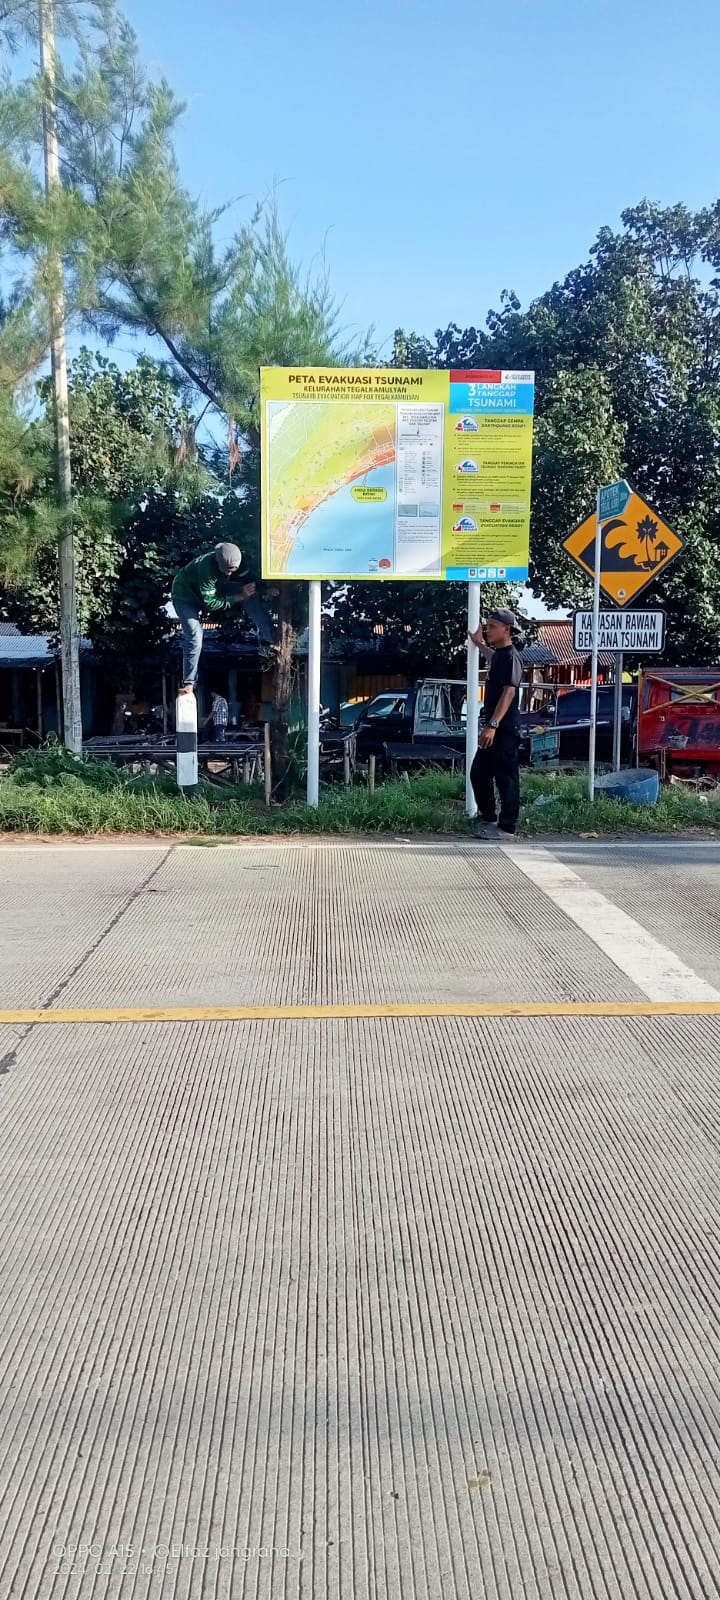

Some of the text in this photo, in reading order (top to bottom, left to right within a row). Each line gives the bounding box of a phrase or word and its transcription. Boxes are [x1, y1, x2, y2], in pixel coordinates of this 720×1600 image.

[289, 375, 423, 385] PETA EVAKUASI TSUNAMI
[468, 384, 476, 397] 3
[468, 398, 517, 407] TSUNAMI
[625, 614, 657, 630] RAWAN
[620, 631, 659, 647] TSUNAMI
